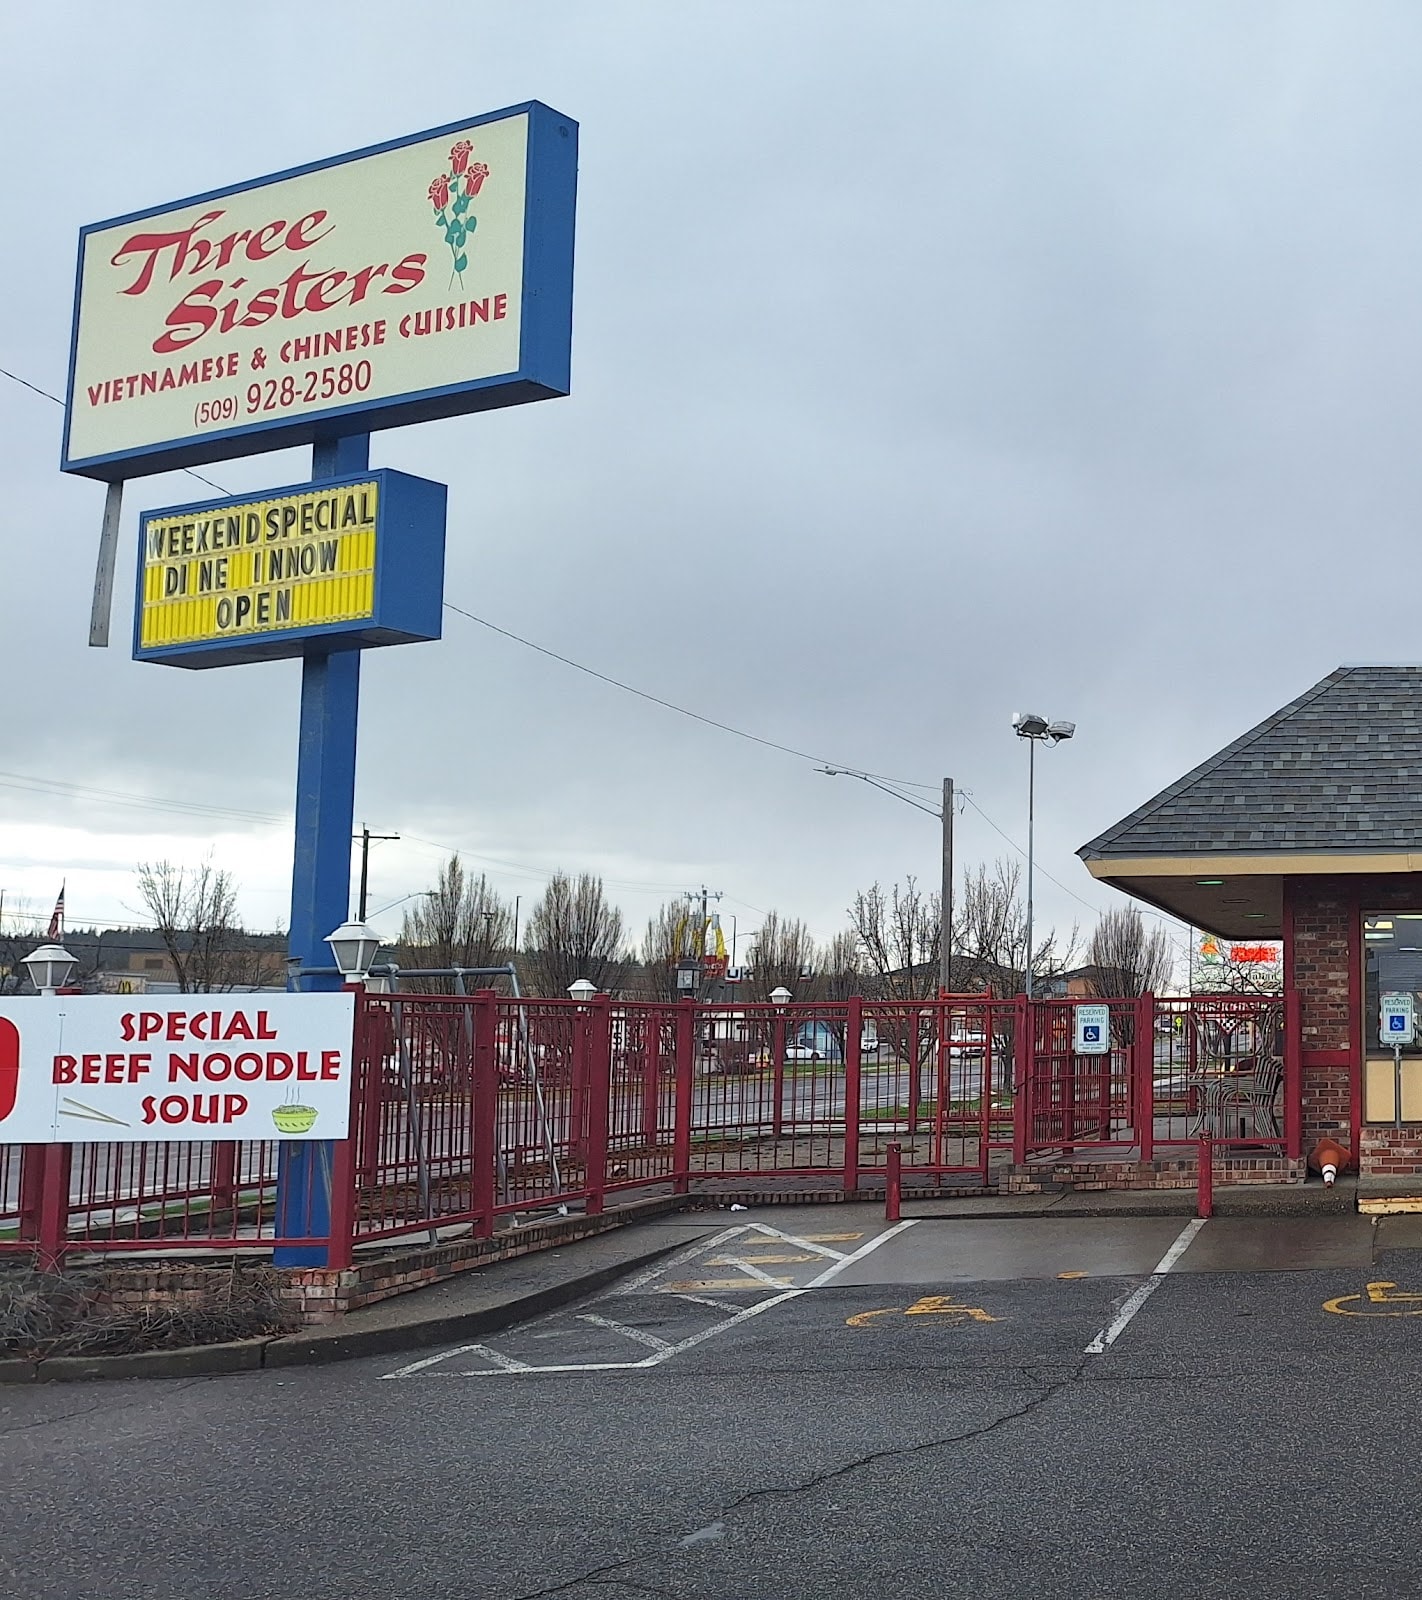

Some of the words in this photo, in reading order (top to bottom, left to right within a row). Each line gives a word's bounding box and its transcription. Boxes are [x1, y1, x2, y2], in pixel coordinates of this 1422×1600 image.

[110, 209, 337, 295] Three
[152, 253, 428, 353] Sisters
[87, 352, 239, 407] VIETNAMESE
[250, 346, 267, 370] &
[280, 319, 386, 363] CHINESE
[399, 293, 509, 339] CUISINE
[193, 396, 239, 427] (509)
[246, 360, 372, 414] 928-2580
[217, 589, 291, 629] OPEN
[119, 1010, 278, 1042] SPECIAL
[1079, 1008, 1106, 1016] RESERVED
[52, 1053, 152, 1085] BEEF
[168, 1050, 341, 1083] NOODLE
[140, 1093, 248, 1125] SOUP
